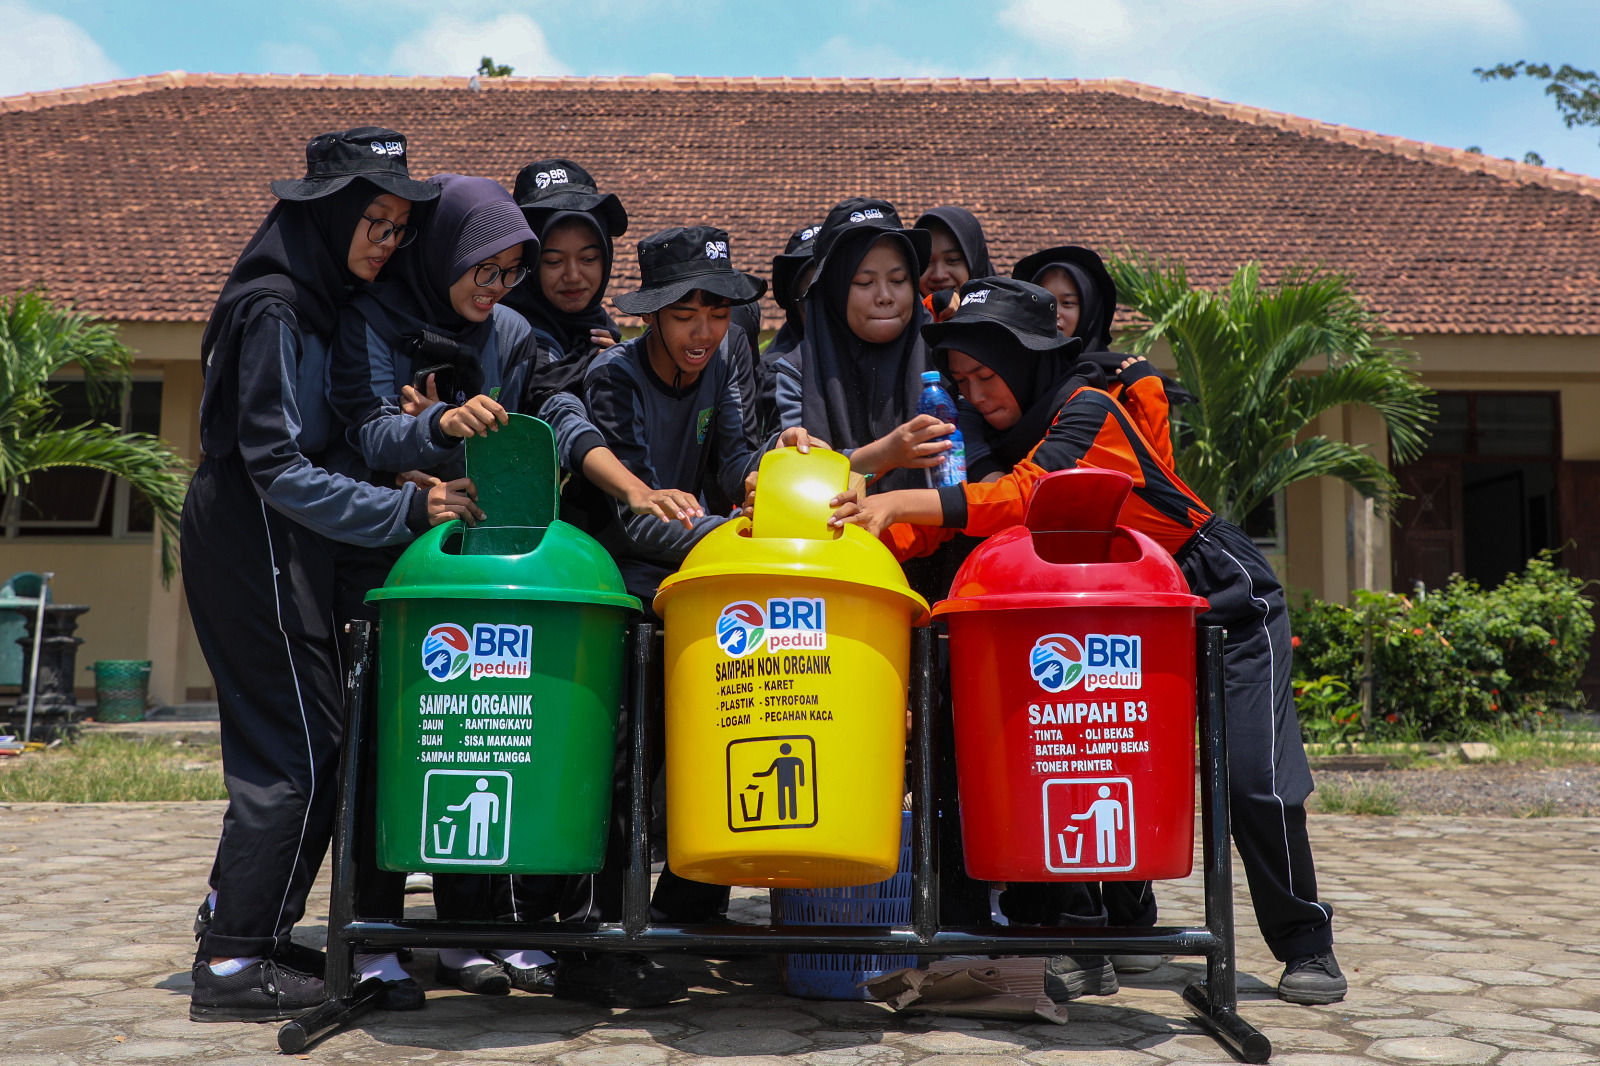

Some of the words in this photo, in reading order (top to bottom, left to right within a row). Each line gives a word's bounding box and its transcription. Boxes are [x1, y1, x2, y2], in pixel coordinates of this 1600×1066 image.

[386, 142, 402, 151] BRI
[550, 169, 566, 179] BRI
[770, 601, 822, 630] BRI
[475, 627, 528, 658] BRI
[770, 633, 822, 650] peduli
[1088, 638, 1137, 668] BRI
[474, 660, 528, 677] peduli
[716, 658, 754, 682] SAMPAH
[758, 656, 780, 676] NON
[784, 656, 831, 674] ORGANIK
[764, 680, 794, 690] KARET
[1088, 672, 1138, 688] peduli
[721, 683, 753, 696] KALENG
[420, 694, 468, 715] SAMPAH
[472, 694, 532, 715] ORGANIK
[720, 698, 754, 711] PLASTIK
[764, 695, 818, 706] STYROFOAM
[765, 710, 806, 722] PECAHAN
[810, 710, 834, 720] KACA
[1028, 702, 1118, 724] SAMPAH
[1124, 701, 1148, 722] B3
[422, 720, 444, 730] DAUN
[465, 719, 532, 730] RANTING/KAYU
[721, 714, 750, 728] LOGAM
[1034, 730, 1063, 740] TINTA
[1085, 728, 1101, 740] OLI
[1104, 728, 1134, 739] BEKAS
[422, 735, 442, 746] BUAH
[464, 736, 484, 746] SISA
[487, 736, 532, 746] MAKANAN
[1036, 744, 1076, 756] BATERAI
[1086, 742, 1118, 754] LAMPU
[1122, 741, 1149, 753] BEKAS
[421, 752, 454, 762] SAMPAH
[457, 752, 490, 762] RUMAH
[493, 752, 531, 762] TANGGA
[1036, 761, 1068, 772] TONER
[1071, 760, 1112, 772] PRINTER
